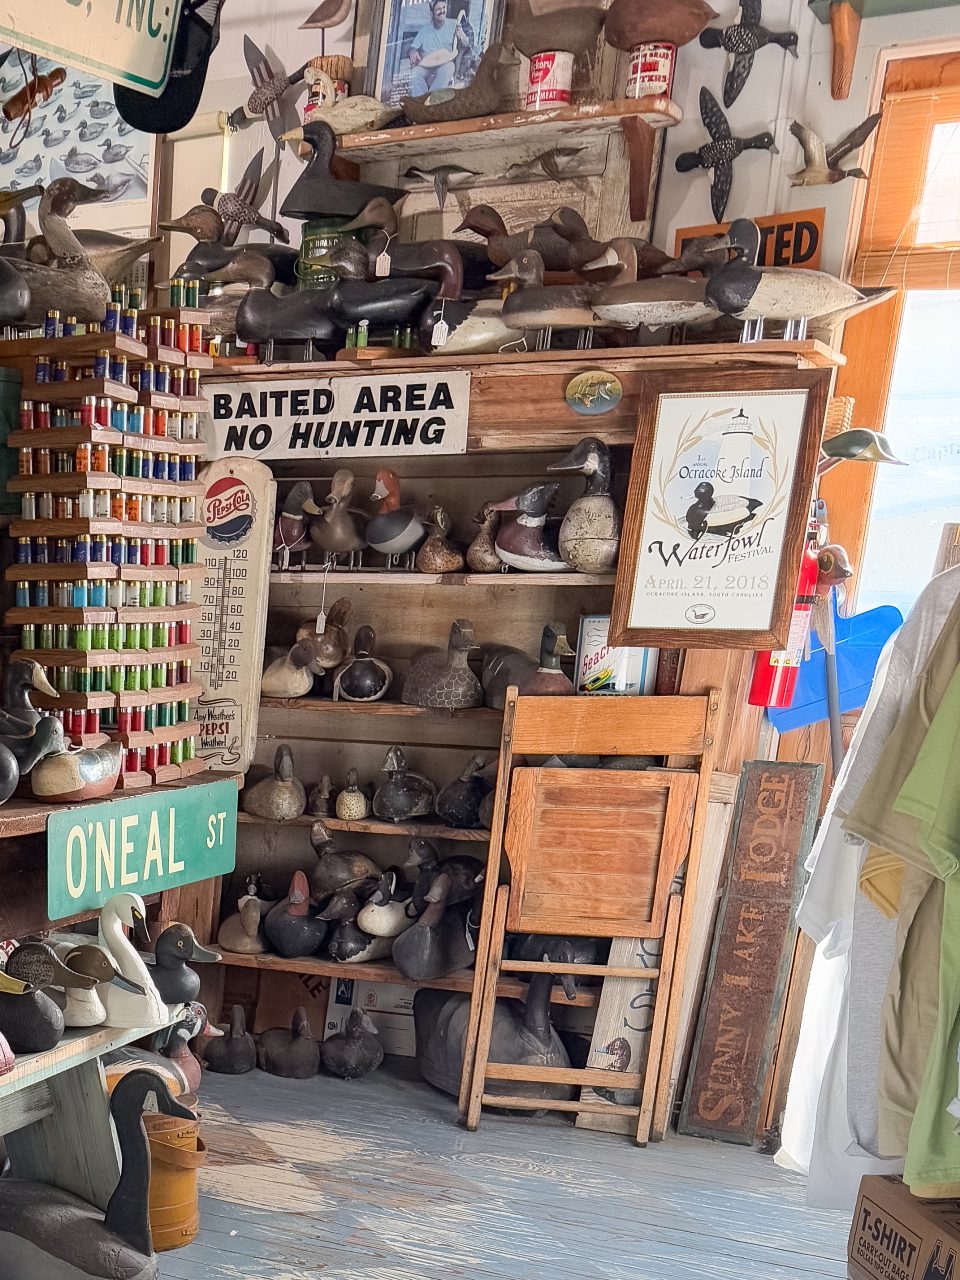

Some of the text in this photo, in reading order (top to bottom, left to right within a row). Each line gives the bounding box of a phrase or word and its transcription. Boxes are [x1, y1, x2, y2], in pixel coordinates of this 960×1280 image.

[214, 382, 455, 420] BAITED AREA
[223, 417, 447, 452] NO HUNTING
[679, 456, 770, 483] Ocracoke Island
[648, 517, 775, 569] Waterfowl
[232, 549, 248, 559] 120
[727, 545, 774, 563] FESTIVAL
[204, 558, 217, 567] 110
[231, 568, 247, 578] 100
[203, 577, 216, 586] 90
[692, 574, 717, 591] 21,
[724, 574, 769, 590] 2018
[231, 586, 244, 596] 80
[202, 594, 215, 604] 70
[230, 604, 242, 614] 60
[201, 612, 213, 622] 50
[229, 622, 241, 631] 40
[200, 629, 212, 639] 30
[227, 638, 240, 648] 20
[201, 646, 211, 655] 10
[200, 661, 210, 671] 10
[225, 670, 237, 680] 20
[193, 708, 235, 721] Any Weather's
[198, 721, 230, 737] PEPSI
[66, 807, 227, 899] O'NEAL ST
[861, 1207, 917, 1268] T-SHIRT
[858, 1237, 893, 1269] CARRY-OUT
